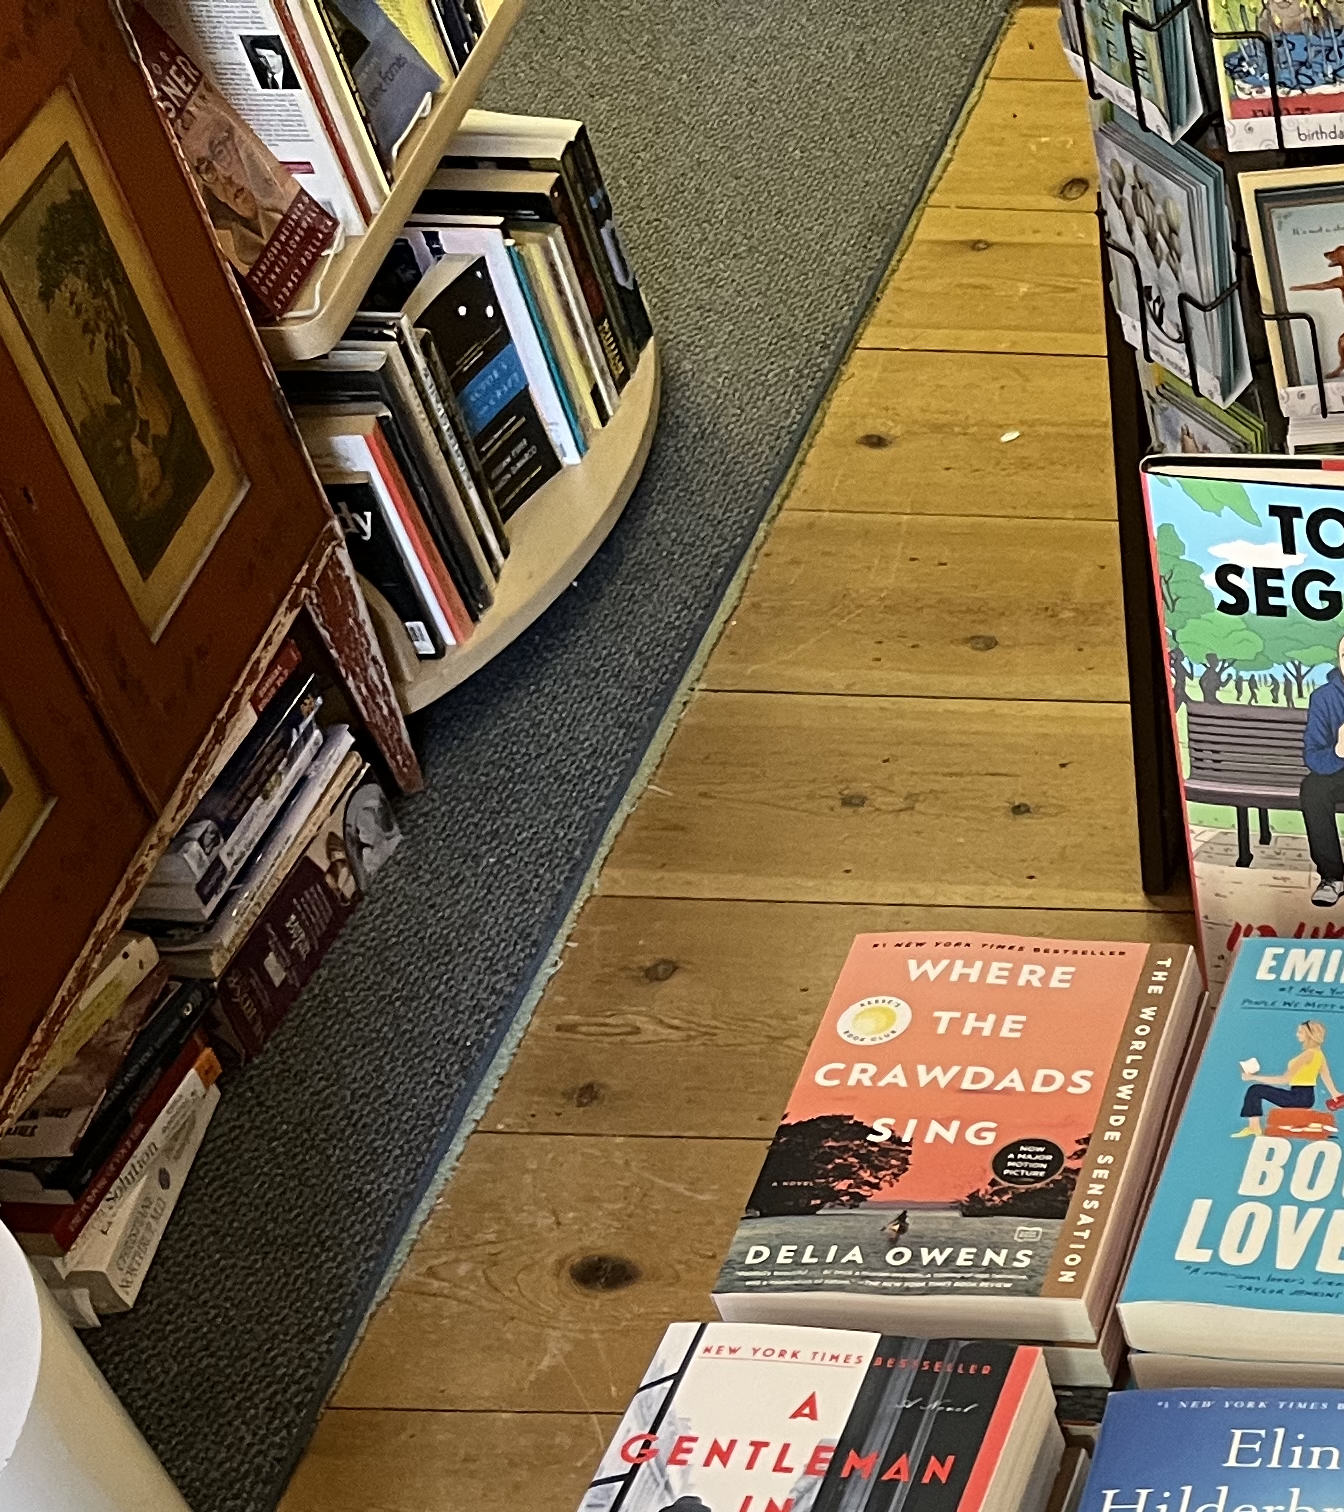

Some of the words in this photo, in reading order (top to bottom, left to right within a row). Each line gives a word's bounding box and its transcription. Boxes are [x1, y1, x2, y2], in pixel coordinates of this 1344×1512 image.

[907, 959, 1076, 988] WHERE
[1146, 958, 1172, 995] THE
[932, 1011, 1027, 1038] THE
[814, 1062, 1094, 1095] CRAWDADS
[1104, 1006, 1157, 1142] WORLDWIDE
[867, 1118, 998, 1145] SING
[1058, 1155, 1114, 1284] SENSATION
[745, 1245, 863, 1266] DELIA
[886, 1247, 1033, 1268] OWENS
[788, 1391, 820, 1422] A
[619, 1433, 958, 1485] GENTLEMAN
[1222, 1427, 1341, 1470] Elin
